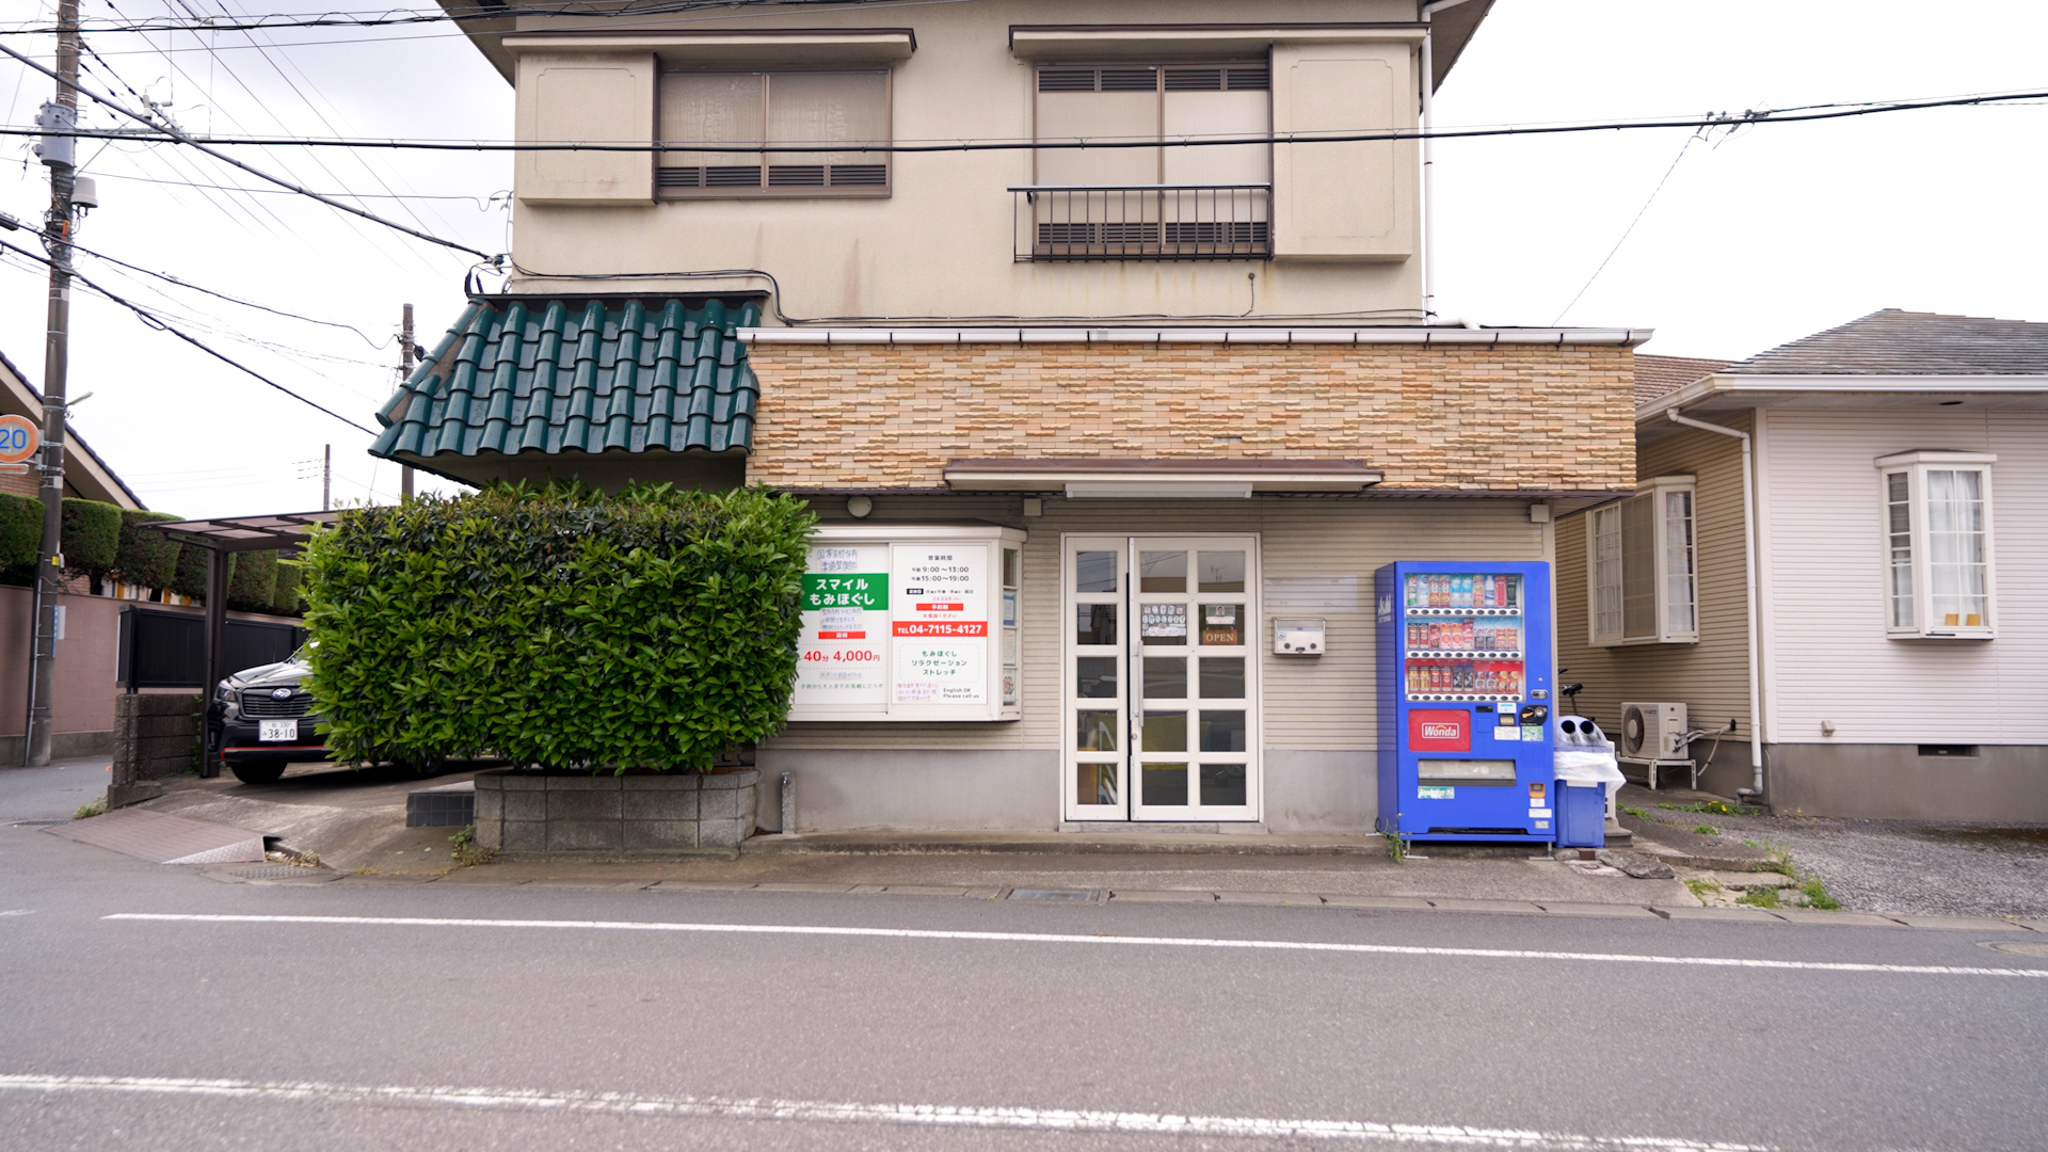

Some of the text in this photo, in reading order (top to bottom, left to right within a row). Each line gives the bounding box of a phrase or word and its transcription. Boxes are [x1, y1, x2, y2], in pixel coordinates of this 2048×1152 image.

[0, 428, 26, 449] 20
[815, 578, 869, 591] スマイル
[809, 592, 875, 606] もみほぐし
[909, 624, 982, 634] 04-7115-4127
[1205, 633, 1234, 642] OPEN
[911, 659, 968, 667] リラクゼーション
[268, 728, 295, 738] 38-10
[1424, 725, 1457, 737] Wonda
